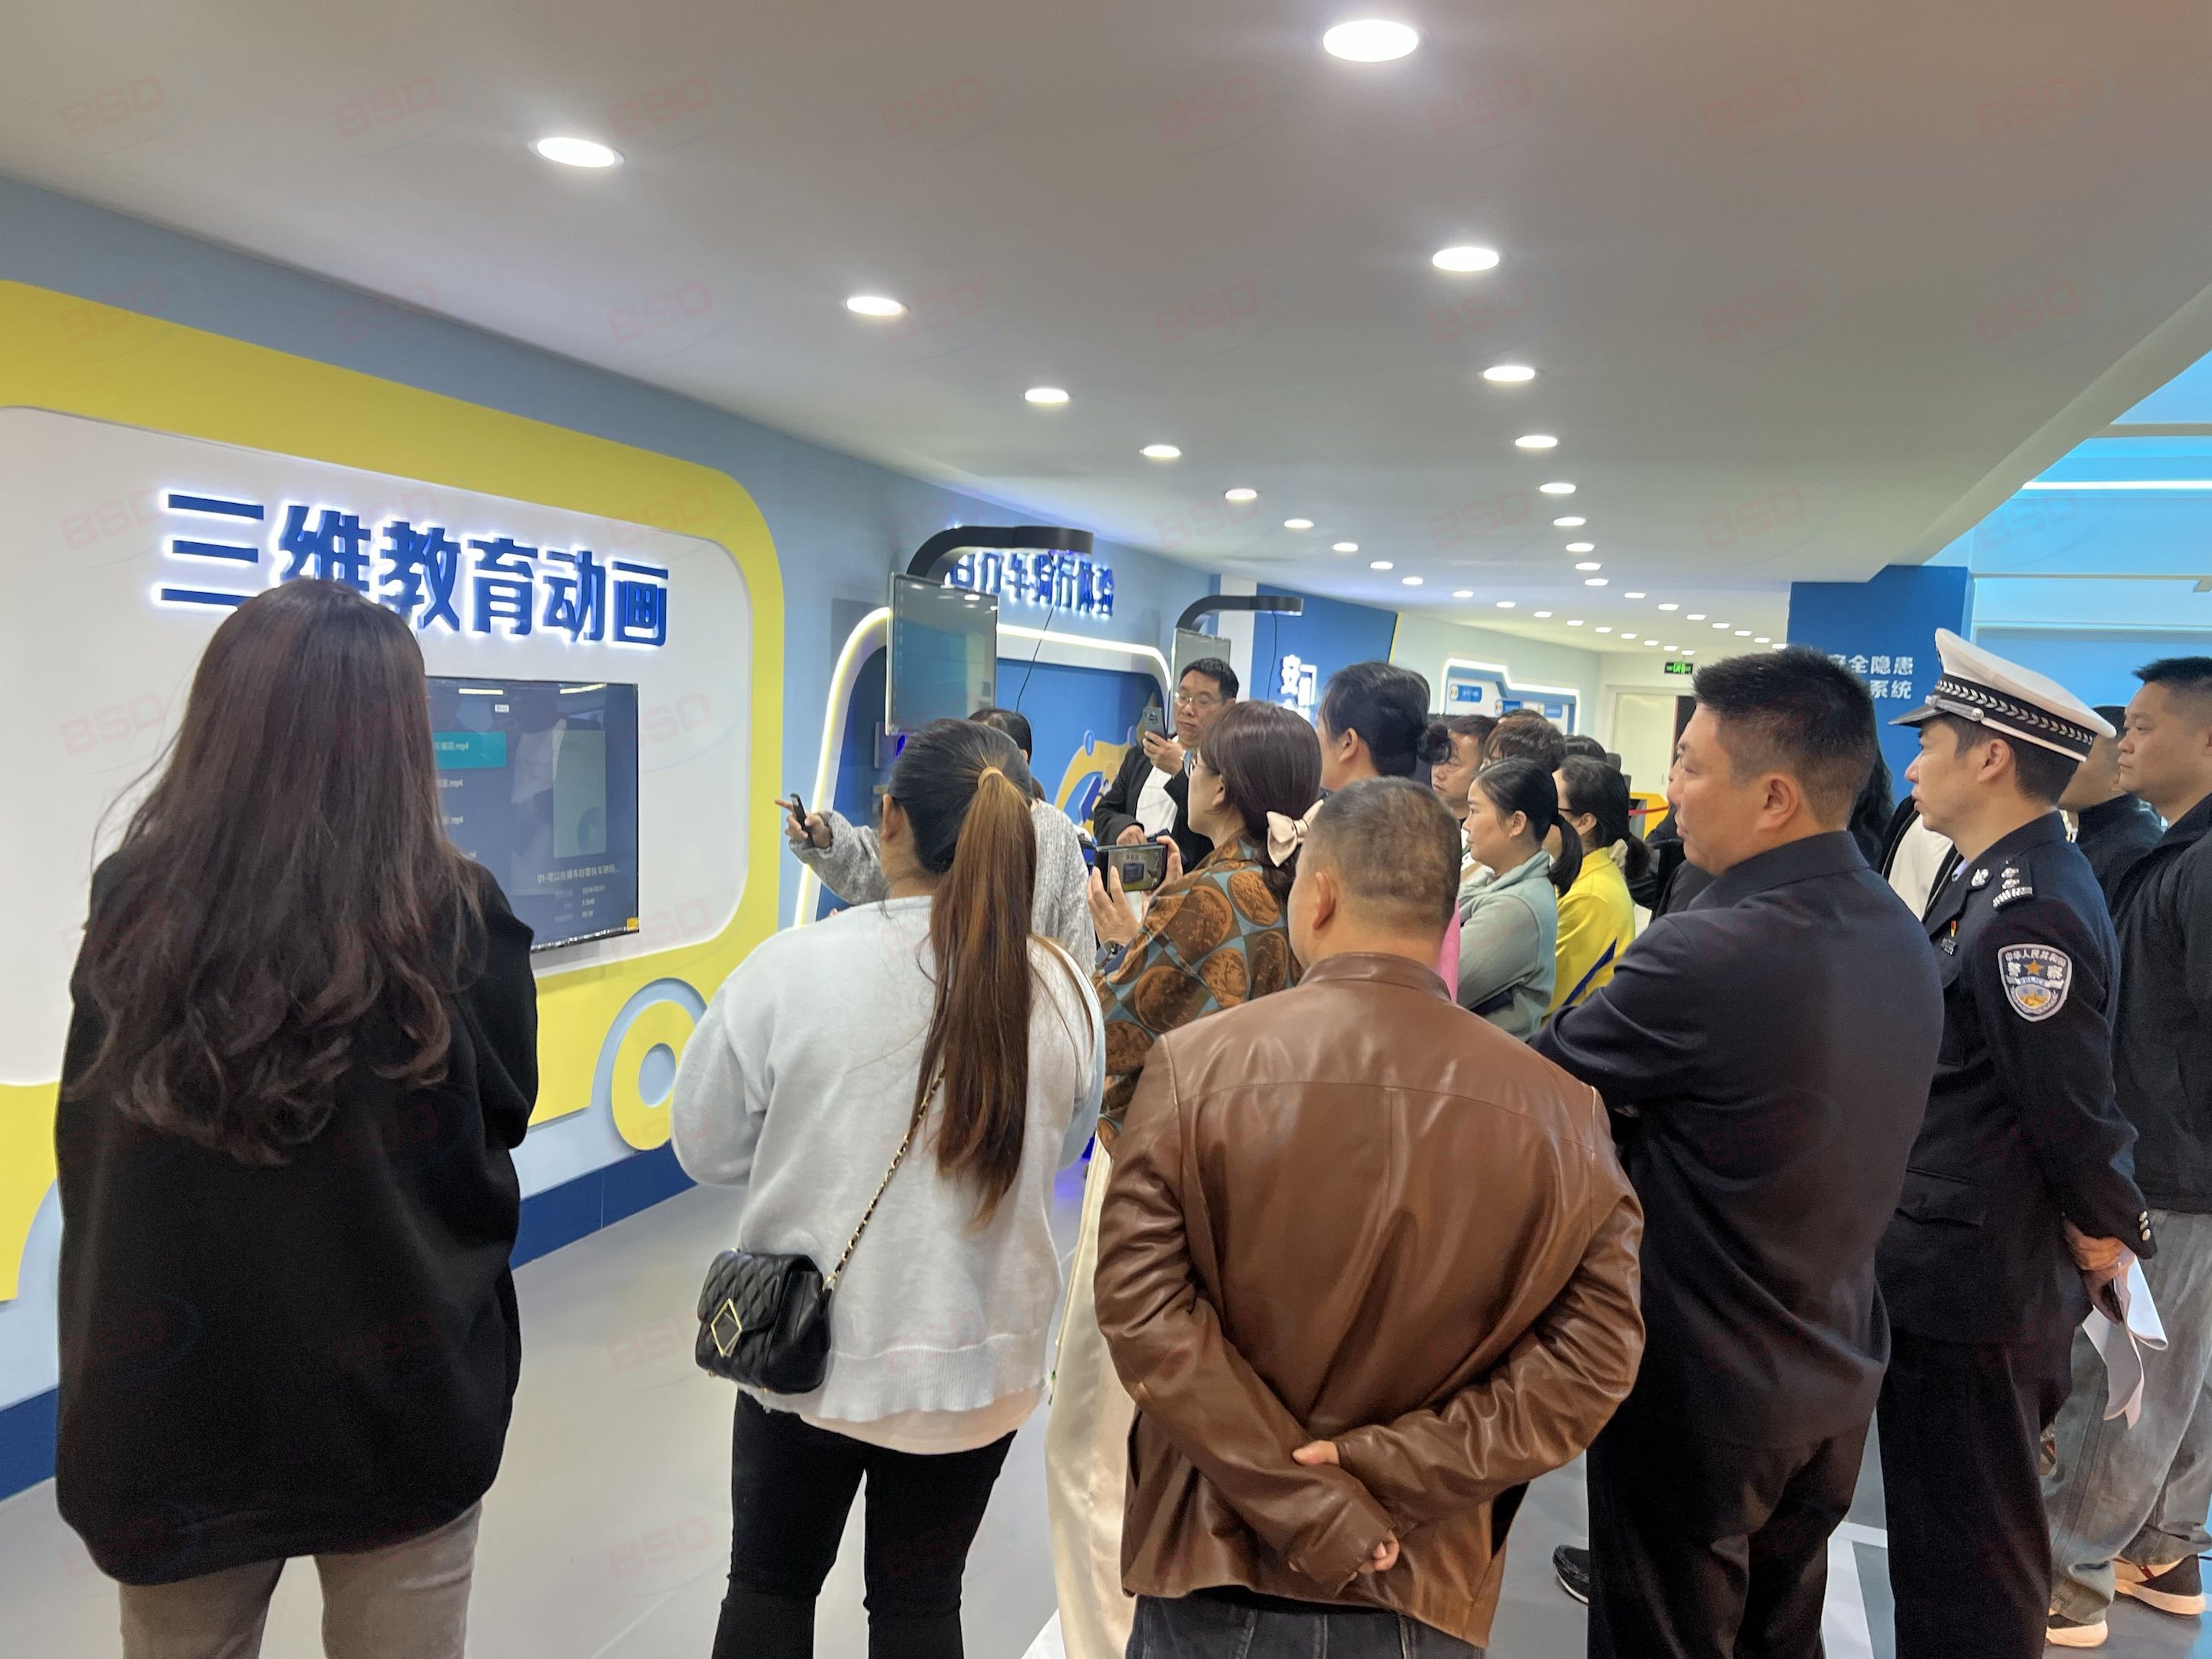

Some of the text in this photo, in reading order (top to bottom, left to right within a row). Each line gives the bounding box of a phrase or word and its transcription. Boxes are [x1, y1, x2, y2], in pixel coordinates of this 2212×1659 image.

[161, 493, 669, 647] 三维教育动画
[1869, 680, 1912, 700] 系统
[2005, 949, 2067, 968] 中华人民共和国
